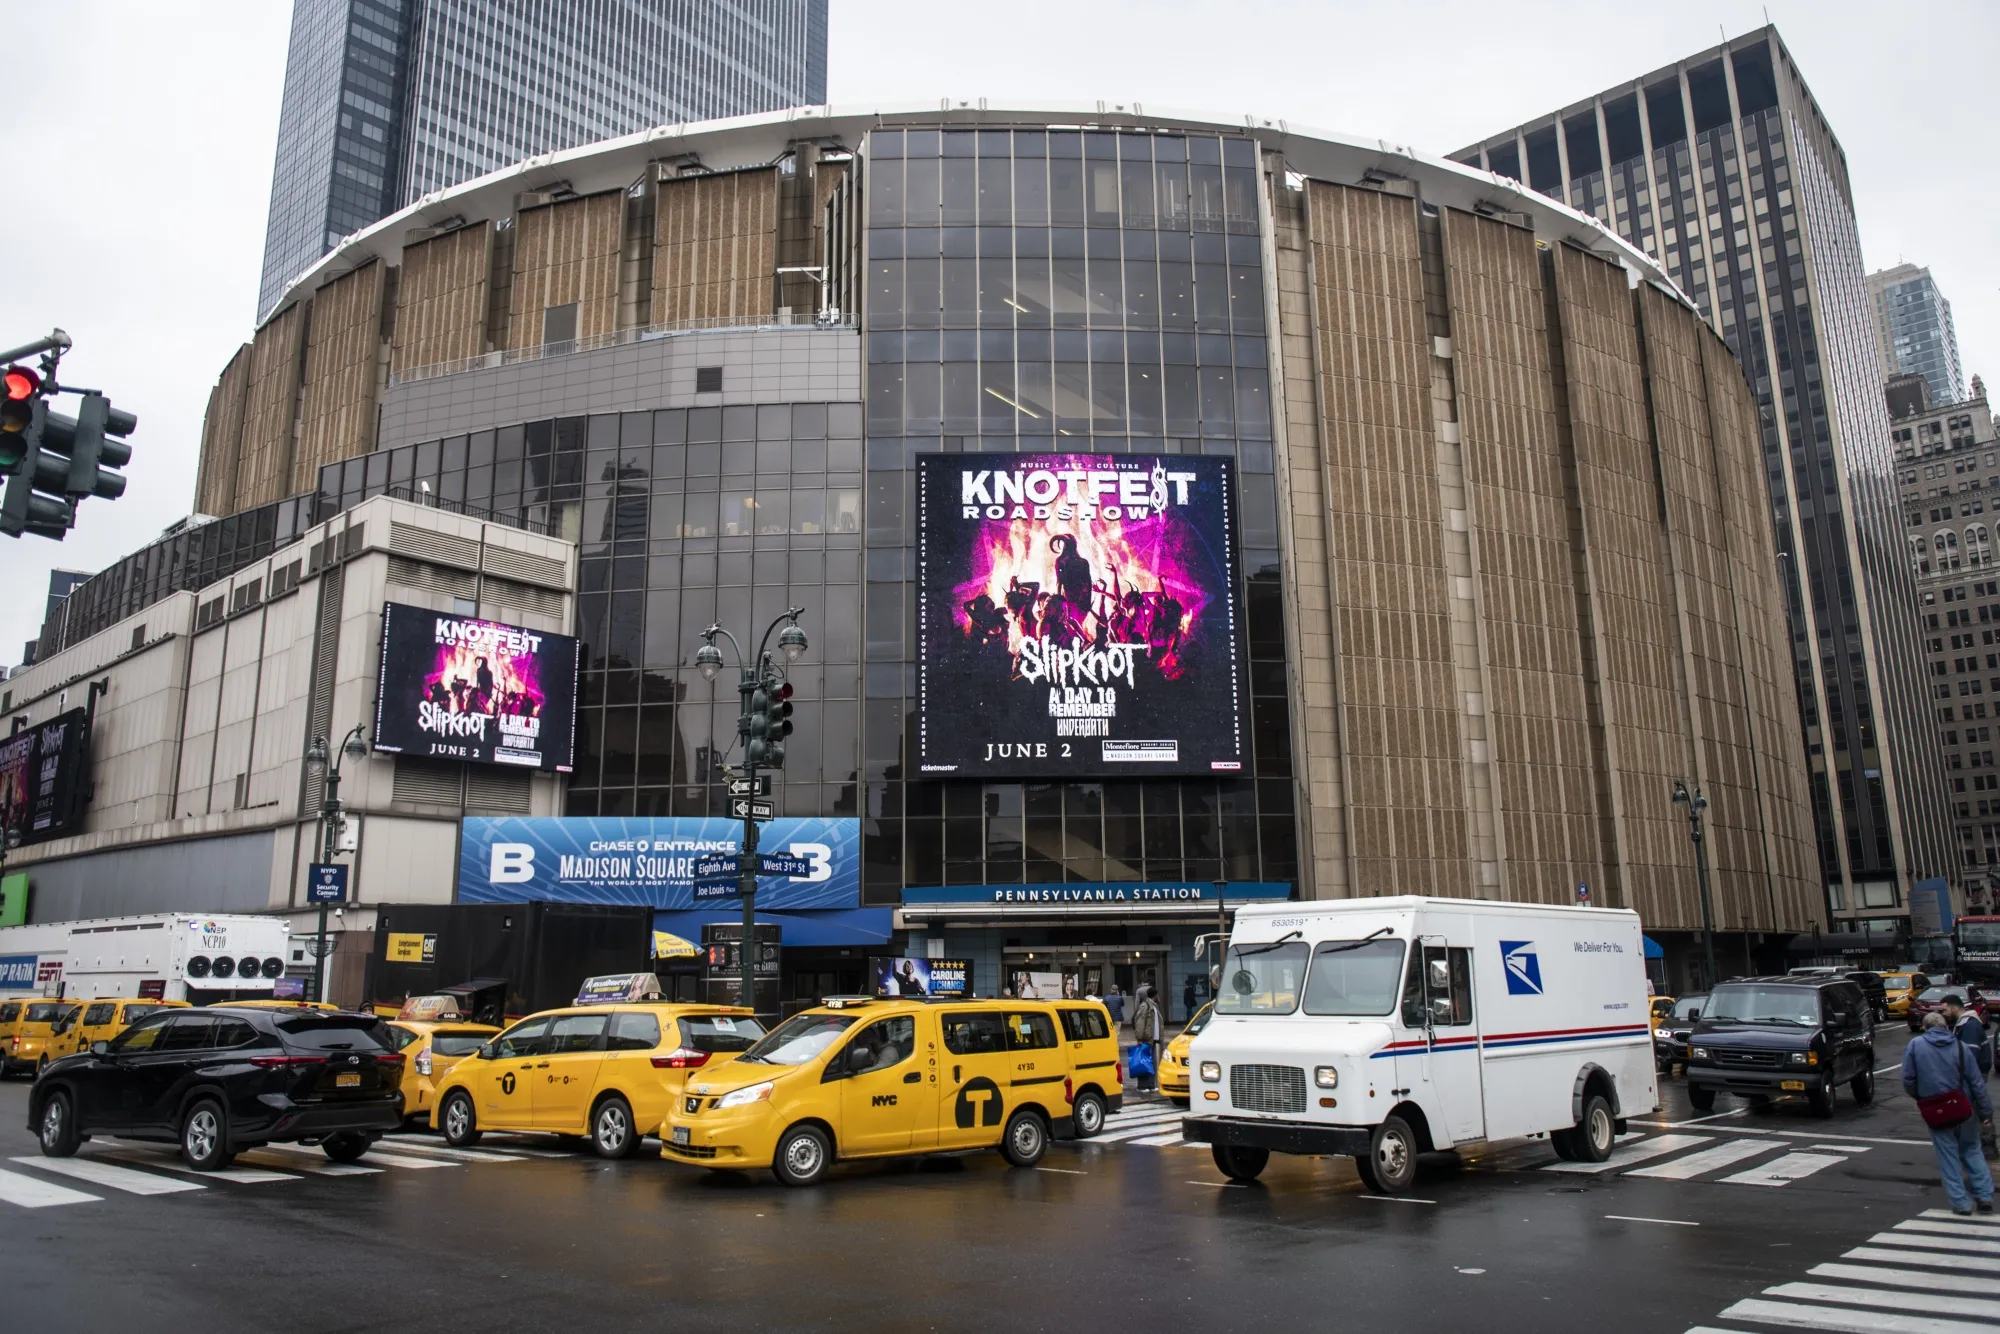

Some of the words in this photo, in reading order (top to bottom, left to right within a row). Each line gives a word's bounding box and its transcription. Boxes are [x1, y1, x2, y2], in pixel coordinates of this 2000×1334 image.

[961, 458, 1196, 522] KNOTFEST
[1049, 687, 1061, 703] A
[1064, 687, 1092, 703] DAY
[1049, 703, 1116, 717] REMEMBER
[430, 743, 467, 757] JUNE
[472, 749, 480, 758] 2
[985, 743, 1048, 761] JUNE
[1061, 743, 1072, 758] 2
[1105, 742, 1140, 750] Montefiore
[733, 783, 743, 791] ONE
[590, 841, 635, 851] CHASE
[654, 841, 736, 851] ENTRANCE
[489, 843, 535, 883] B
[560, 855, 630, 879] MADISON
[636, 854, 695, 880] SQUARE
[698, 862, 721, 876] Eighth
[722, 861, 736, 871] Ave
[763, 860, 783, 871] West
[784, 861, 797, 872] 31st
[797, 863, 806, 873] St
[316, 884, 339, 892] Security
[697, 886, 708, 896] Joe
[708, 884, 725, 895] Louis
[995, 889, 1125, 901] PENNSYLVANIA
[1133, 888, 1201, 900] STATION
[202, 935, 227, 949] NCP10
[398, 940, 421, 948] Entertainment
[423, 939, 436, 953] CAT
[1574, 941, 1583, 953] We
[1584, 941, 1602, 953] Deliver
[1603, 942, 1612, 953] For
[397, 948, 412, 956] Services
[8, 963, 36, 982] RANK
[37, 962, 63, 982] ESPN
[930, 970, 966, 980] CAROLINE
[936, 980, 965, 990] CHANGE
[827, 1000, 843, 1008] 4Y30
[1017, 1062, 1035, 1071] 4Y30
[872, 1095, 897, 1107] NYC
